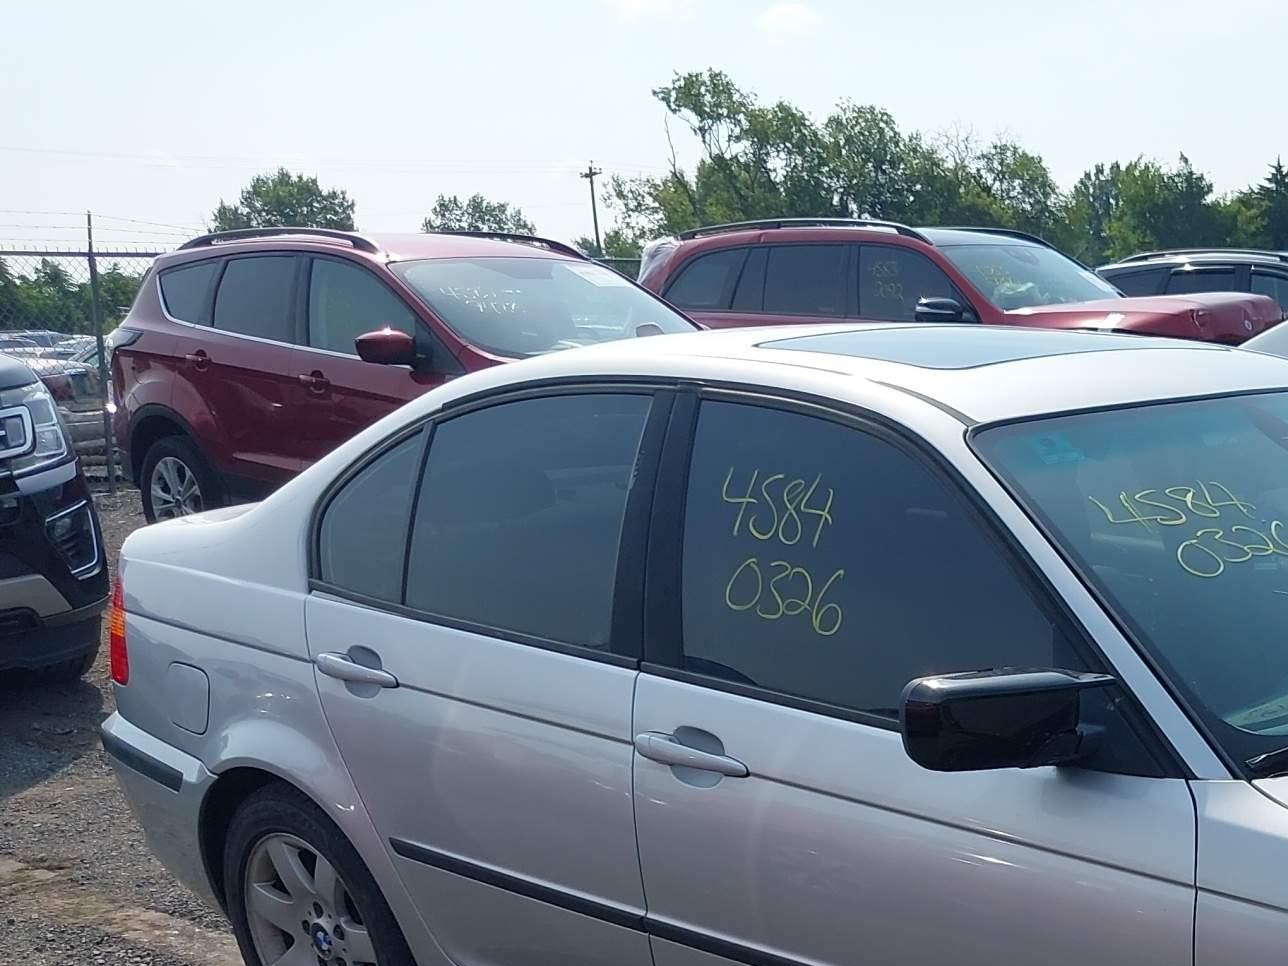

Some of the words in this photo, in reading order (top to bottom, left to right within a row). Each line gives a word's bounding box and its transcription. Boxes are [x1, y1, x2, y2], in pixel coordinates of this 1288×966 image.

[722, 465, 834, 548] 4584
[1088, 479, 1257, 536] 4584
[725, 557, 845, 636] 0326
